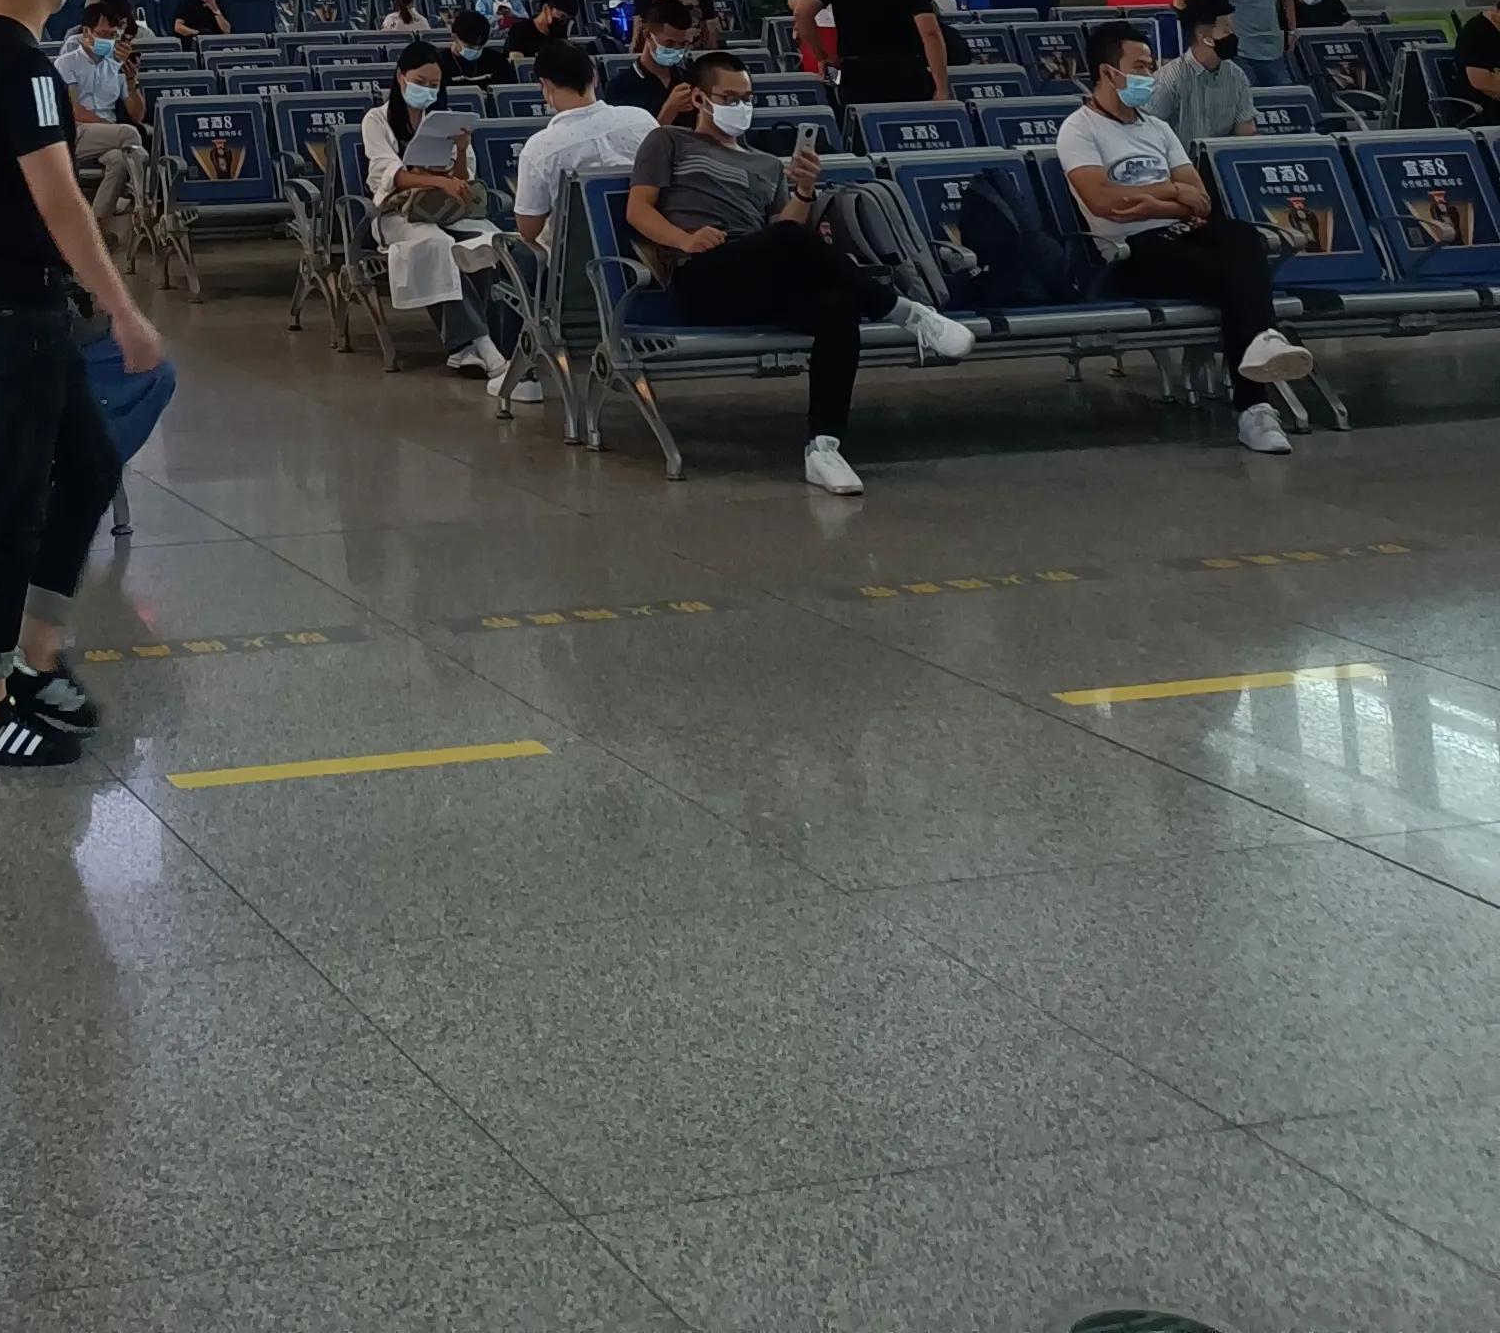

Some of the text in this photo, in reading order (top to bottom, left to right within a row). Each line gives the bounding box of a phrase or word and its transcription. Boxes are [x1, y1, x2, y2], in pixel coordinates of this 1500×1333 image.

[197, 116, 233, 129] 宣酒8
[1019, 119, 1058, 135] 宣酒8
[900, 125, 940, 140] 宣酒8
[1262, 163, 1310, 183] 宣酒8
[1402, 158, 1449, 177] 宣酒8
